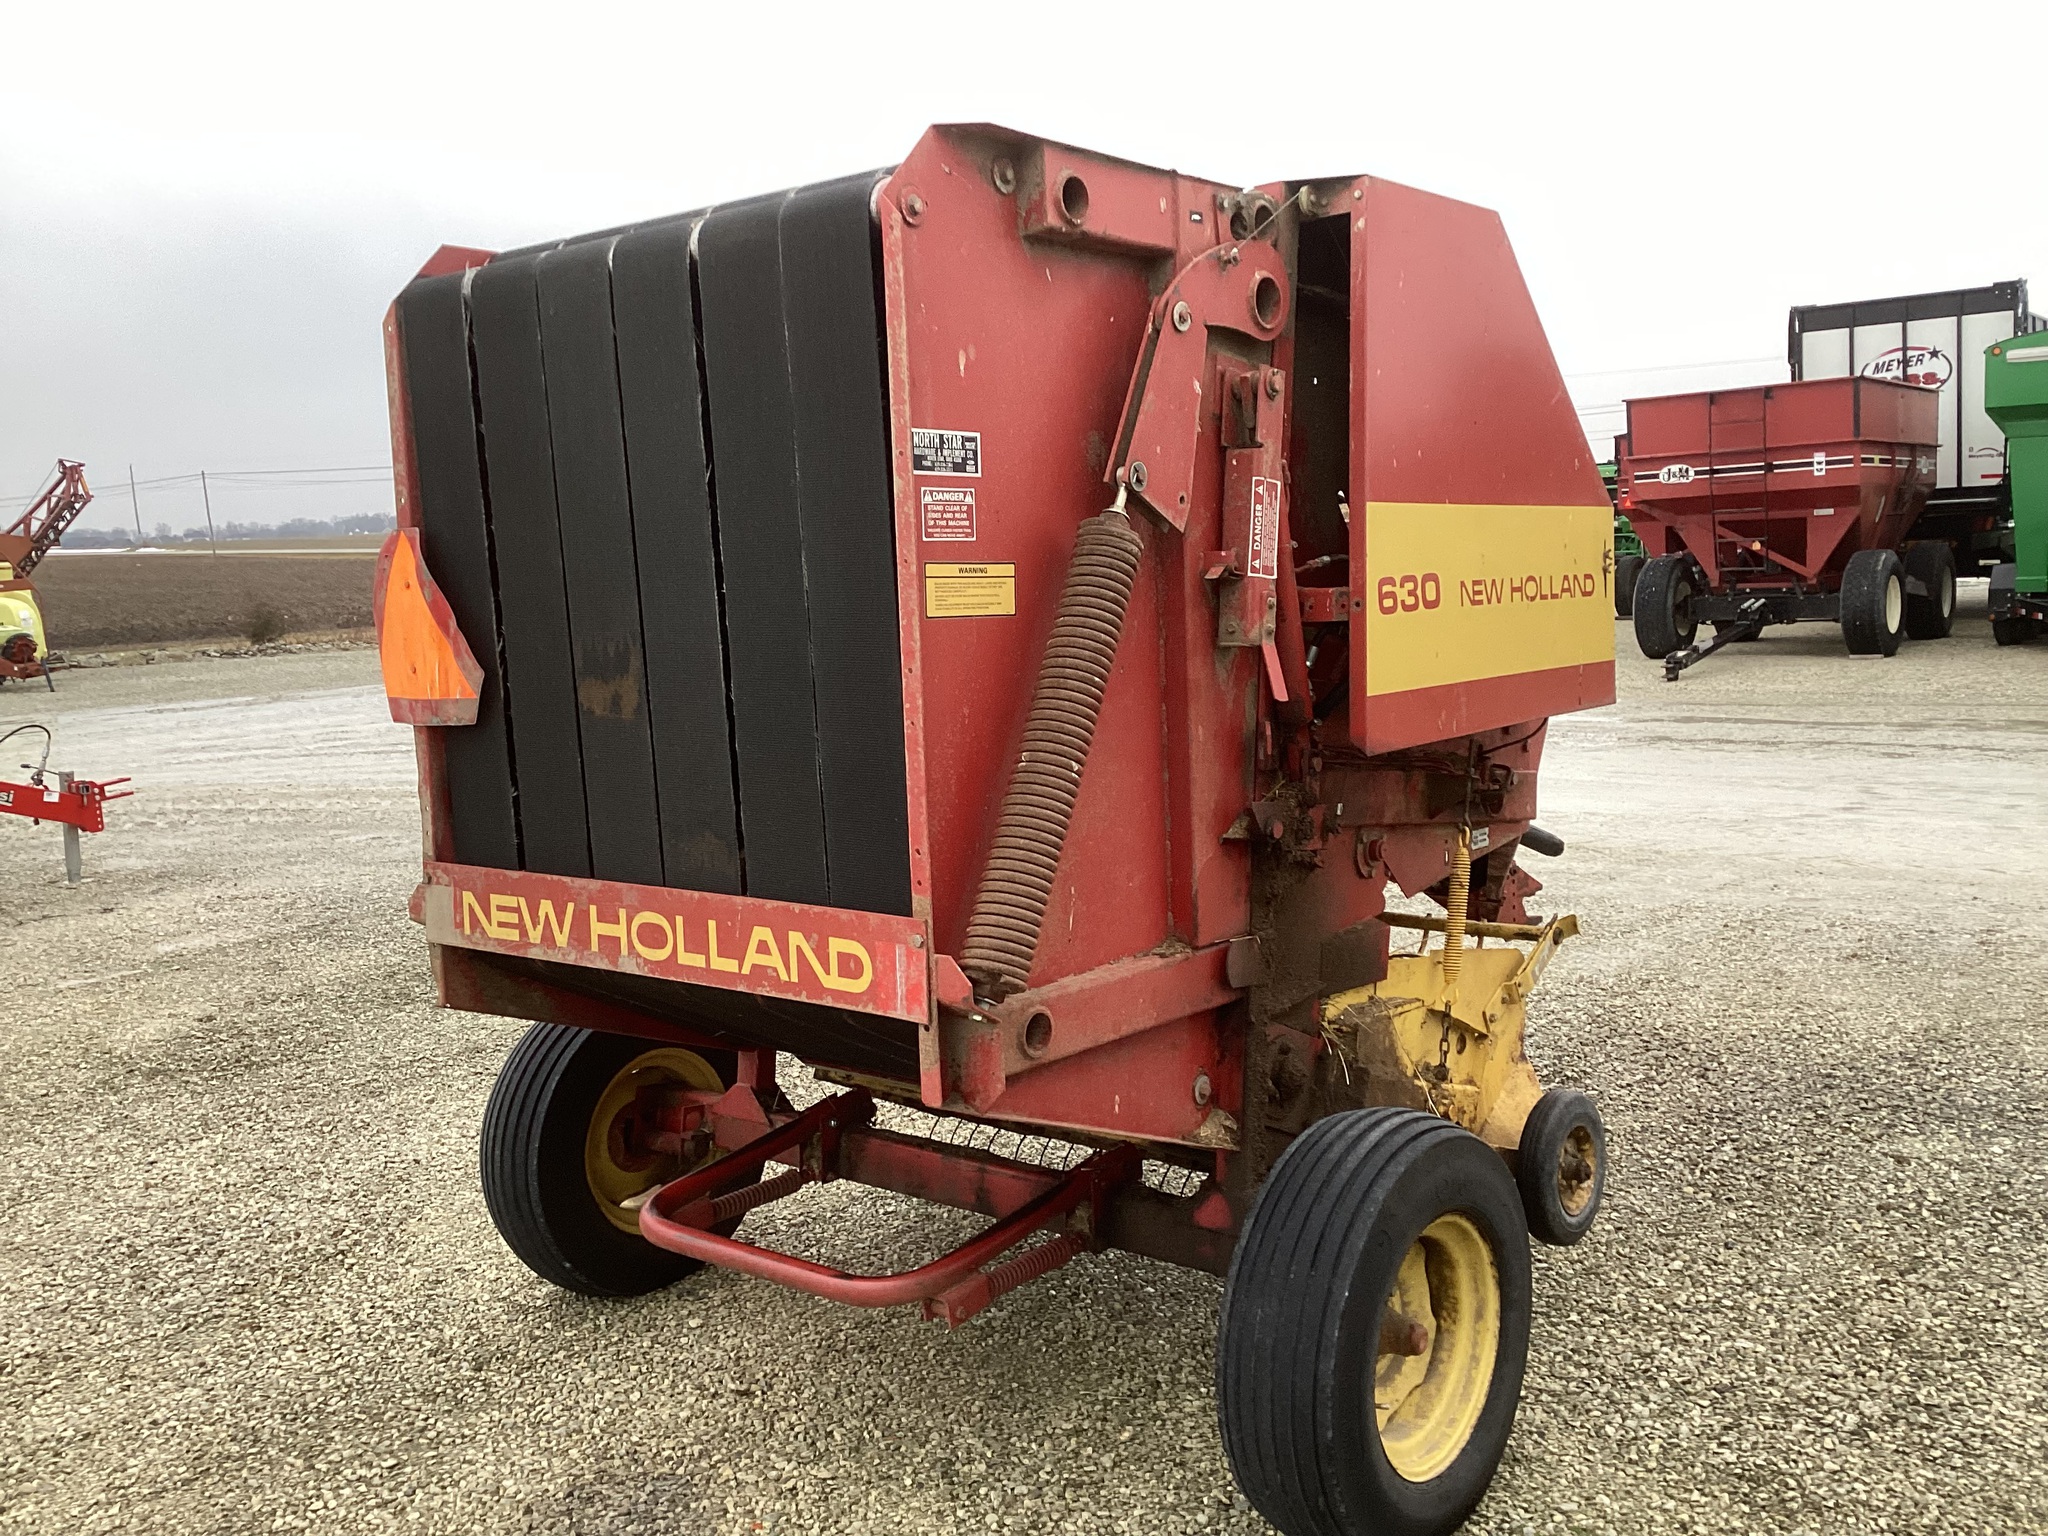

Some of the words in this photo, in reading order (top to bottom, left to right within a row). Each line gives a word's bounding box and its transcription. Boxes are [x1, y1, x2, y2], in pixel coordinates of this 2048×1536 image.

[1872, 353, 1926, 375] MEYER
[913, 432, 940, 448] NORTH
[943, 434, 963, 449] STAR
[1662, 465, 1691, 482] J&M
[932, 491, 964, 501] DANGER
[1253, 503, 1263, 551] DANGER
[1377, 572, 1441, 615] 630
[1459, 578, 1504, 607] NEW
[1510, 573, 1595, 603] HOLLAND
[462, 890, 574, 948] NEW
[590, 904, 873, 994] HOLLAND
